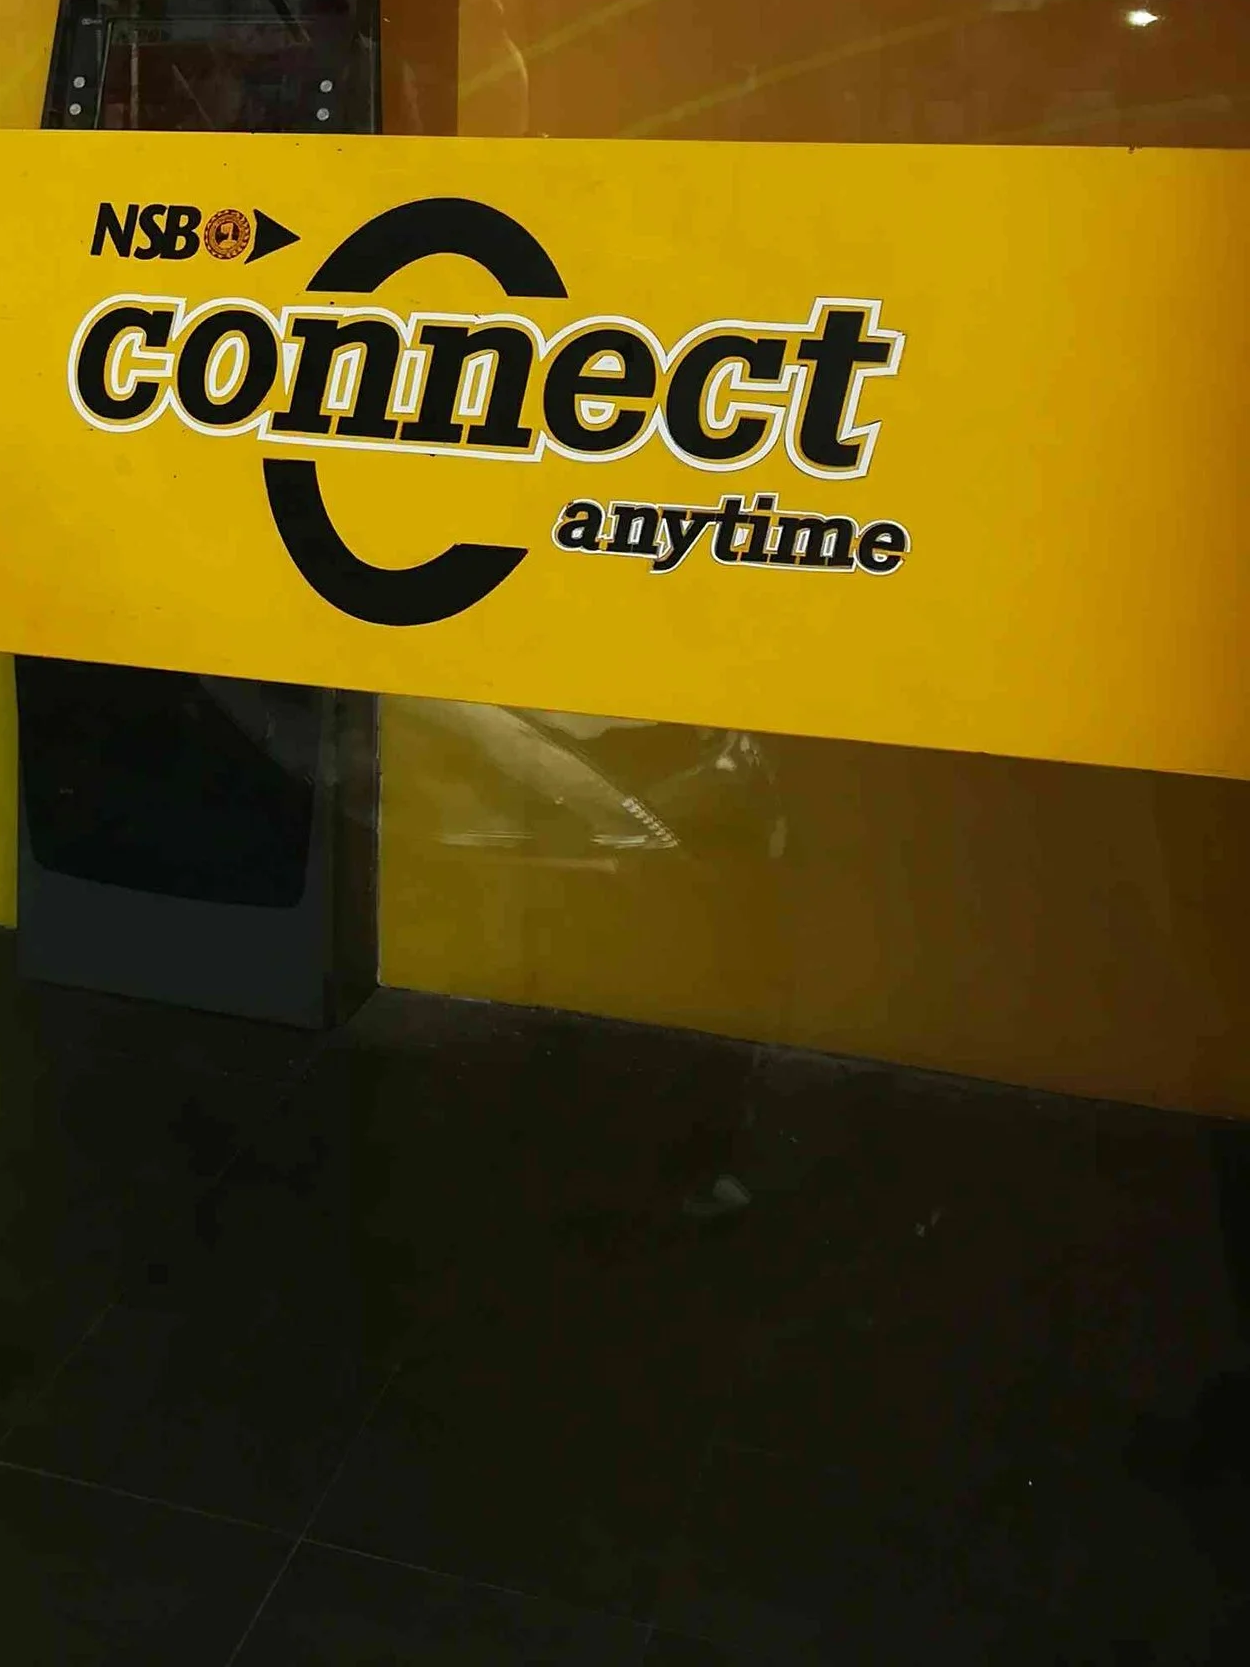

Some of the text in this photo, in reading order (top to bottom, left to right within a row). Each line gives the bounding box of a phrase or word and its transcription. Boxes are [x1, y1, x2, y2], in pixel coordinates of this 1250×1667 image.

[90, 201, 203, 260] NSB
[68, 294, 904, 478] connect
[551, 492, 910, 574] anytime
